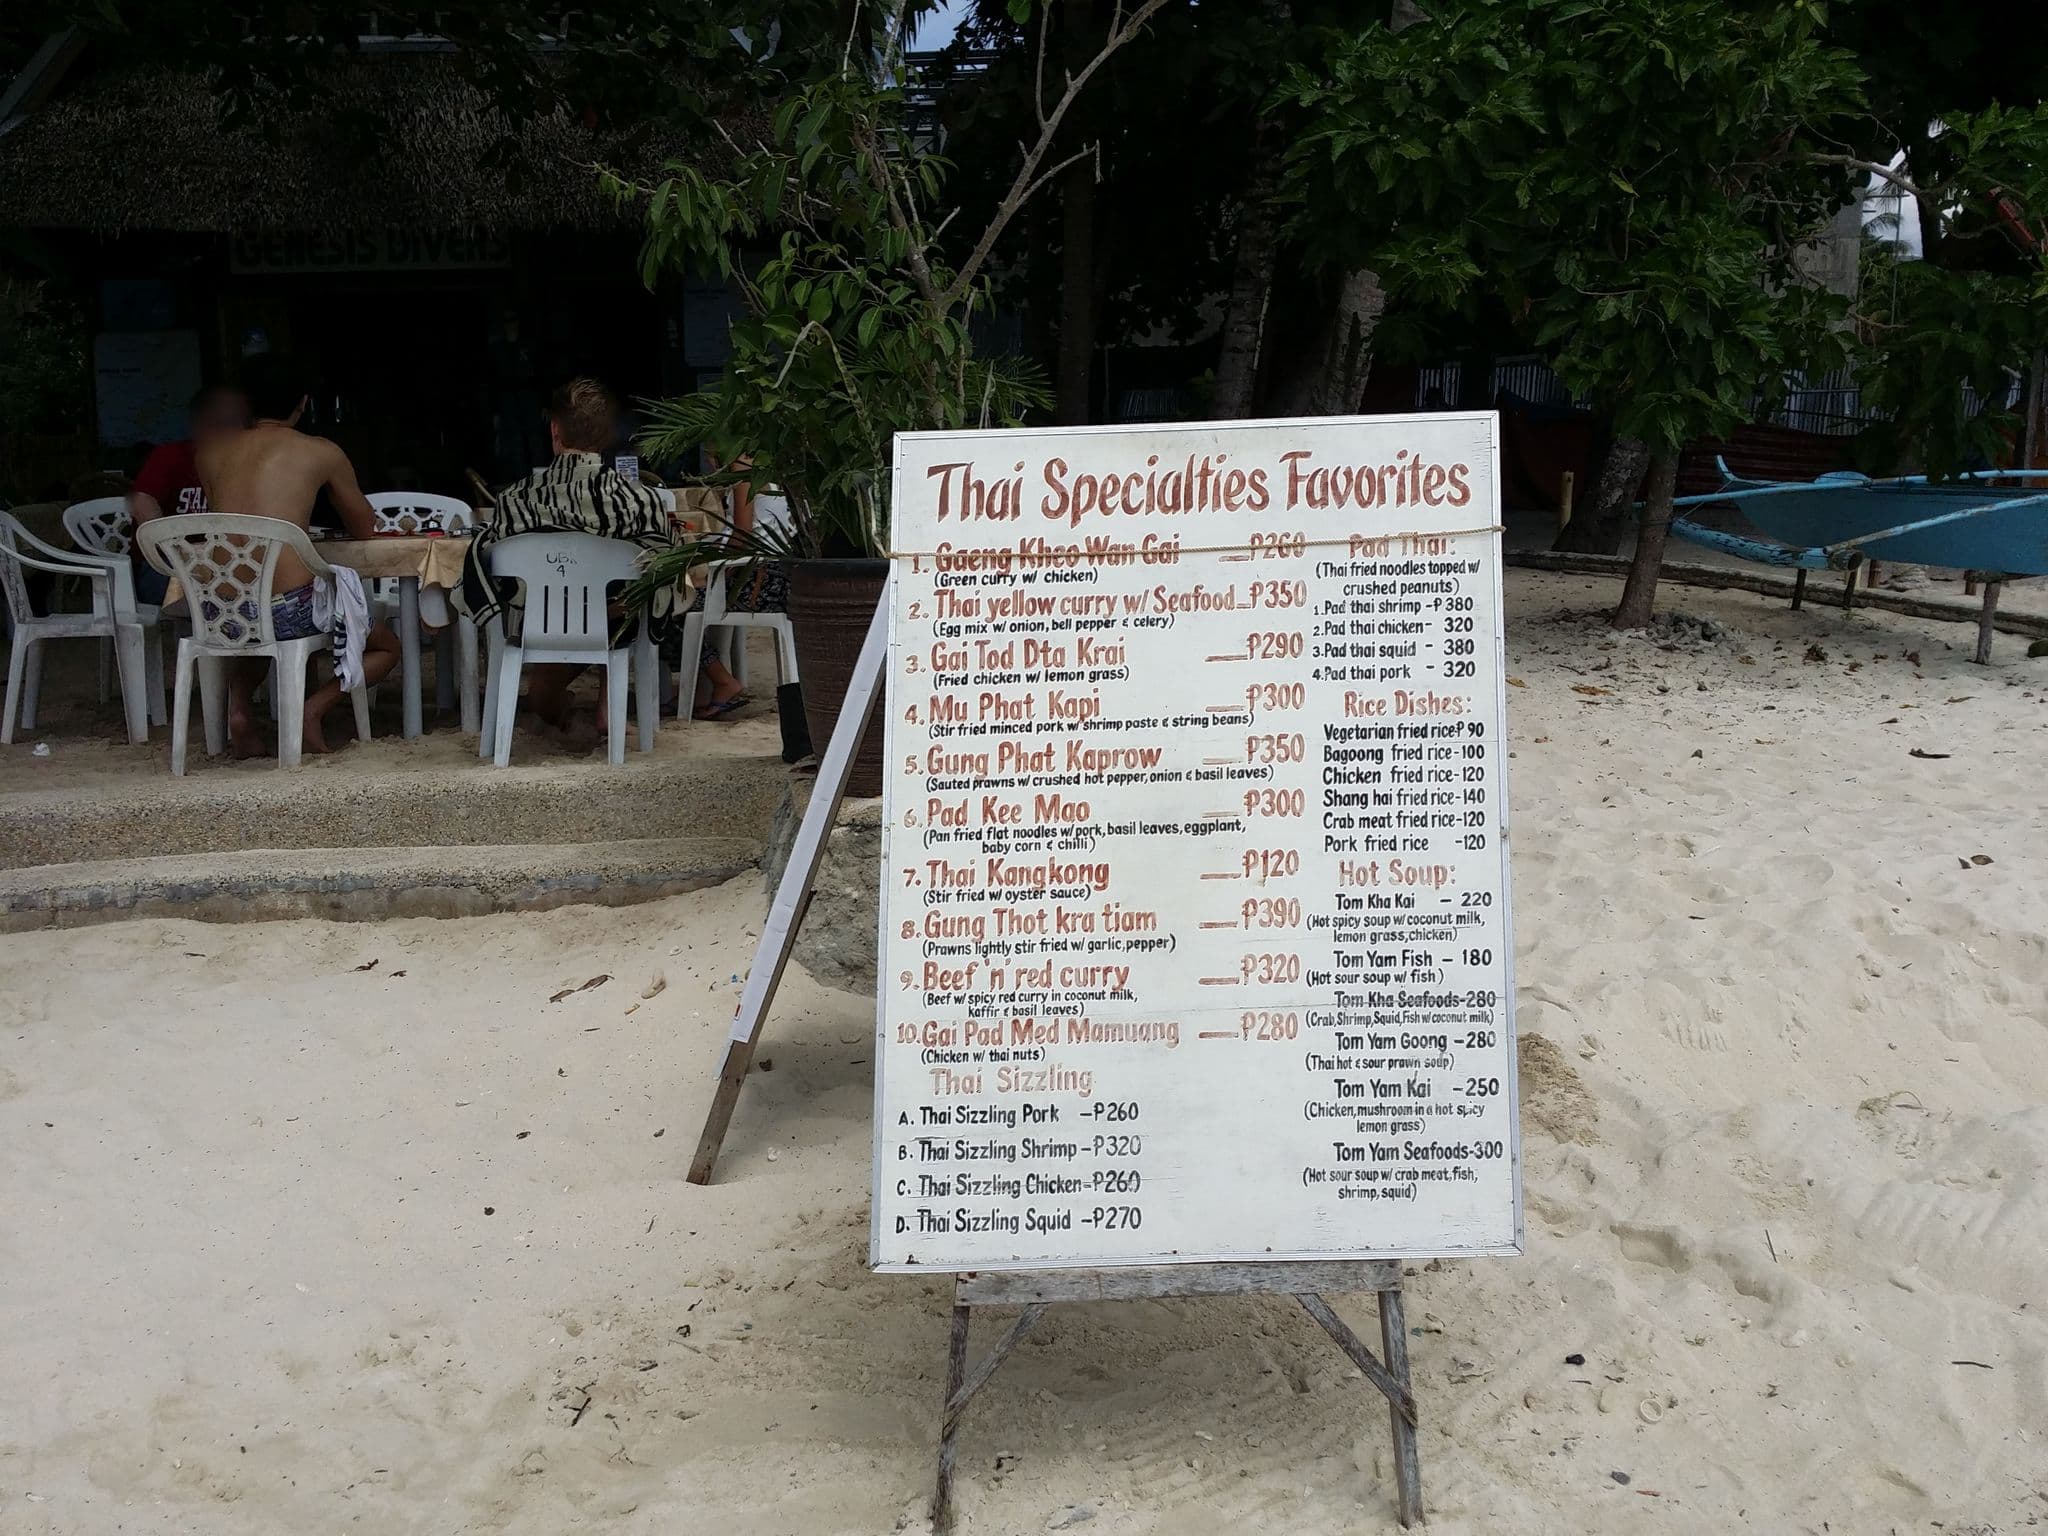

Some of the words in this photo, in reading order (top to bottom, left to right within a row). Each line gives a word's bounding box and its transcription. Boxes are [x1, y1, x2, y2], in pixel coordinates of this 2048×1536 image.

[927, 461, 1024, 522] Thai
[1041, 453, 1270, 529] Specialties
[1279, 449, 1471, 511] Favorites
[934, 571, 976, 588] (Green
[1044, 567, 1098, 584] chicken)
[1316, 562, 1348, 578] (Thai
[1350, 562, 1378, 576] fried
[1379, 560, 1426, 576] noodles
[1428, 560, 1466, 578] topped
[1343, 580, 1396, 596] crushed
[1400, 578, 1460, 598] peanuts)
[934, 589, 980, 619] Thai
[985, 589, 1056, 623] yellow
[1060, 593, 1118, 618] curry
[1123, 589, 1149, 615] w/
[1378, 599, 1421, 615] shrimp
[1445, 597, 1473, 611] 380
[932, 622, 961, 638] (Egg
[965, 622, 988, 635] mix
[1010, 620, 1049, 632] onion,
[1052, 618, 1072, 630] bell
[1076, 618, 1116, 631] pepper
[1133, 614, 1174, 629] celery)
[1444, 618, 1473, 632] 320
[931, 641, 968, 672] Gai
[974, 640, 1014, 671] Tod
[1023, 639, 1066, 669] Dta
[1077, 636, 1125, 668] Krai
[1379, 641, 1416, 658] squid
[1444, 639, 1474, 656] 380
[933, 674, 968, 690] (Fried
[974, 672, 1021, 686] chicken
[1044, 669, 1084, 682] lemon
[1088, 666, 1129, 683] grass)
[1380, 664, 1410, 682] pork
[1443, 661, 1476, 678] 320
[929, 694, 968, 724] Mu
[979, 692, 1035, 721] Phat
[1049, 688, 1100, 722] Kapi
[1344, 690, 1386, 718] Rice
[1394, 690, 1472, 716] Dishes:
[929, 724, 953, 740] (Stir
[958, 722, 986, 736] fried
[990, 721, 1032, 736] minced
[1036, 721, 1064, 736] pork
[1083, 718, 1122, 732] shrimp
[1125, 718, 1158, 732] paste
[1171, 714, 1209, 728] string
[1212, 712, 1254, 726] beans)
[1324, 724, 1394, 744] Vegetarian
[1398, 723, 1428, 739] fried
[1468, 722, 1484, 737] 90
[927, 744, 989, 780] Gung
[998, 742, 1056, 774] Phat
[1066, 740, 1162, 780] Kaprow
[1324, 746, 1383, 764] Bagoong
[1391, 744, 1424, 760] fried
[926, 775, 970, 792] (Sauted
[972, 777, 1015, 791] prawns
[1032, 774, 1080, 787] crushed
[1084, 772, 1104, 785] hot
[1195, 769, 1223, 781] basil
[1226, 766, 1274, 780] leaves)
[1322, 768, 1381, 784] Chicken
[1322, 790, 1369, 810] Shang
[1373, 789, 1393, 806] hai
[928, 798, 968, 828] Pad
[982, 796, 1022, 825] Kee
[1034, 794, 1090, 824] Mao
[1322, 812, 1354, 829] Crab
[1359, 812, 1393, 828] meat
[923, 829, 950, 850] (Pan
[954, 828, 982, 841] fried
[987, 828, 1009, 840] flat
[1013, 826, 1058, 839] noodles
[982, 842, 1009, 855] baby
[1014, 841, 1041, 851] corn
[1058, 837, 1096, 852] chilli)
[1324, 836, 1357, 852] Pork
[1364, 835, 1397, 851] fried
[1402, 834, 1429, 850] rice
[926, 860, 975, 888] Thai
[987, 857, 1110, 891] Kangkong
[1339, 859, 1380, 888] Hot
[1389, 859, 1456, 890] Soup:
[1005, 889, 1046, 903] oyster
[1050, 885, 1091, 900] sauce)
[1336, 894, 1362, 910] Tom
[1368, 894, 1391, 909] Kha
[1395, 893, 1415, 908] Kai
[1461, 892, 1492, 907] 220
[924, 910, 985, 941] Gung
[992, 908, 1049, 937] Thot
[1056, 906, 1095, 933] kra
[1101, 902, 1156, 932] tiam
[1306, 914, 1330, 930] (Hot
[1332, 914, 1360, 929] spicy
[1364, 914, 1390, 929] soup
[1456, 913, 1485, 926] milk,
[922, 941, 971, 958] (Prawns
[974, 941, 1011, 957] lightly
[1333, 951, 1363, 968] Tom
[1368, 951, 1397, 966] Yam
[1402, 950, 1432, 966] Fish
[1462, 950, 1492, 966] 180
[924, 961, 979, 990] Beef
[1015, 960, 1052, 989] red
[1060, 966, 1130, 992] curry
[922, 992, 952, 1007] (Beef
[968, 992, 996, 1006] spicy
[1065, 990, 1106, 1000] coconut
[1109, 990, 1138, 1002] milk,
[1012, 1005, 1037, 1016] basil
[1041, 1003, 1084, 1016] leaves)
[922, 1021, 957, 1048] Gai
[964, 1021, 1003, 1046] Pad
[1011, 1019, 1059, 1046] Med
[1068, 1019, 1179, 1048] Mamuang
[1335, 1033, 1364, 1050] Tom
[1368, 1033, 1396, 1049] Yam
[1400, 1032, 1447, 1051] Goong
[921, 1049, 969, 1064] (Chicken
[989, 1050, 1010, 1061] thai
[1013, 1049, 1046, 1061] nuts)
[929, 1068, 982, 1095] Thai
[998, 1064, 1093, 1097] Sizzling
[898, 1112, 914, 1126] A.
[919, 1106, 951, 1125] Thai
[955, 1105, 1016, 1128] Sizzling
[1023, 1104, 1059, 1124] Pork
[899, 1145, 913, 1160] B.
[919, 1141, 949, 1161] Thai
[954, 1140, 1016, 1162] Sizzling
[1021, 1139, 1077, 1161] Shrimp
[1333, 1142, 1364, 1161] Tom
[1369, 1142, 1399, 1160] Yam
[1303, 1167, 1326, 1186] (Hot
[1330, 1168, 1352, 1182] sour
[1355, 1168, 1378, 1183] soup
[1395, 1167, 1419, 1180] crab
[954, 1209, 1019, 1233] Sizzling
[1025, 1209, 1071, 1235] Squid
